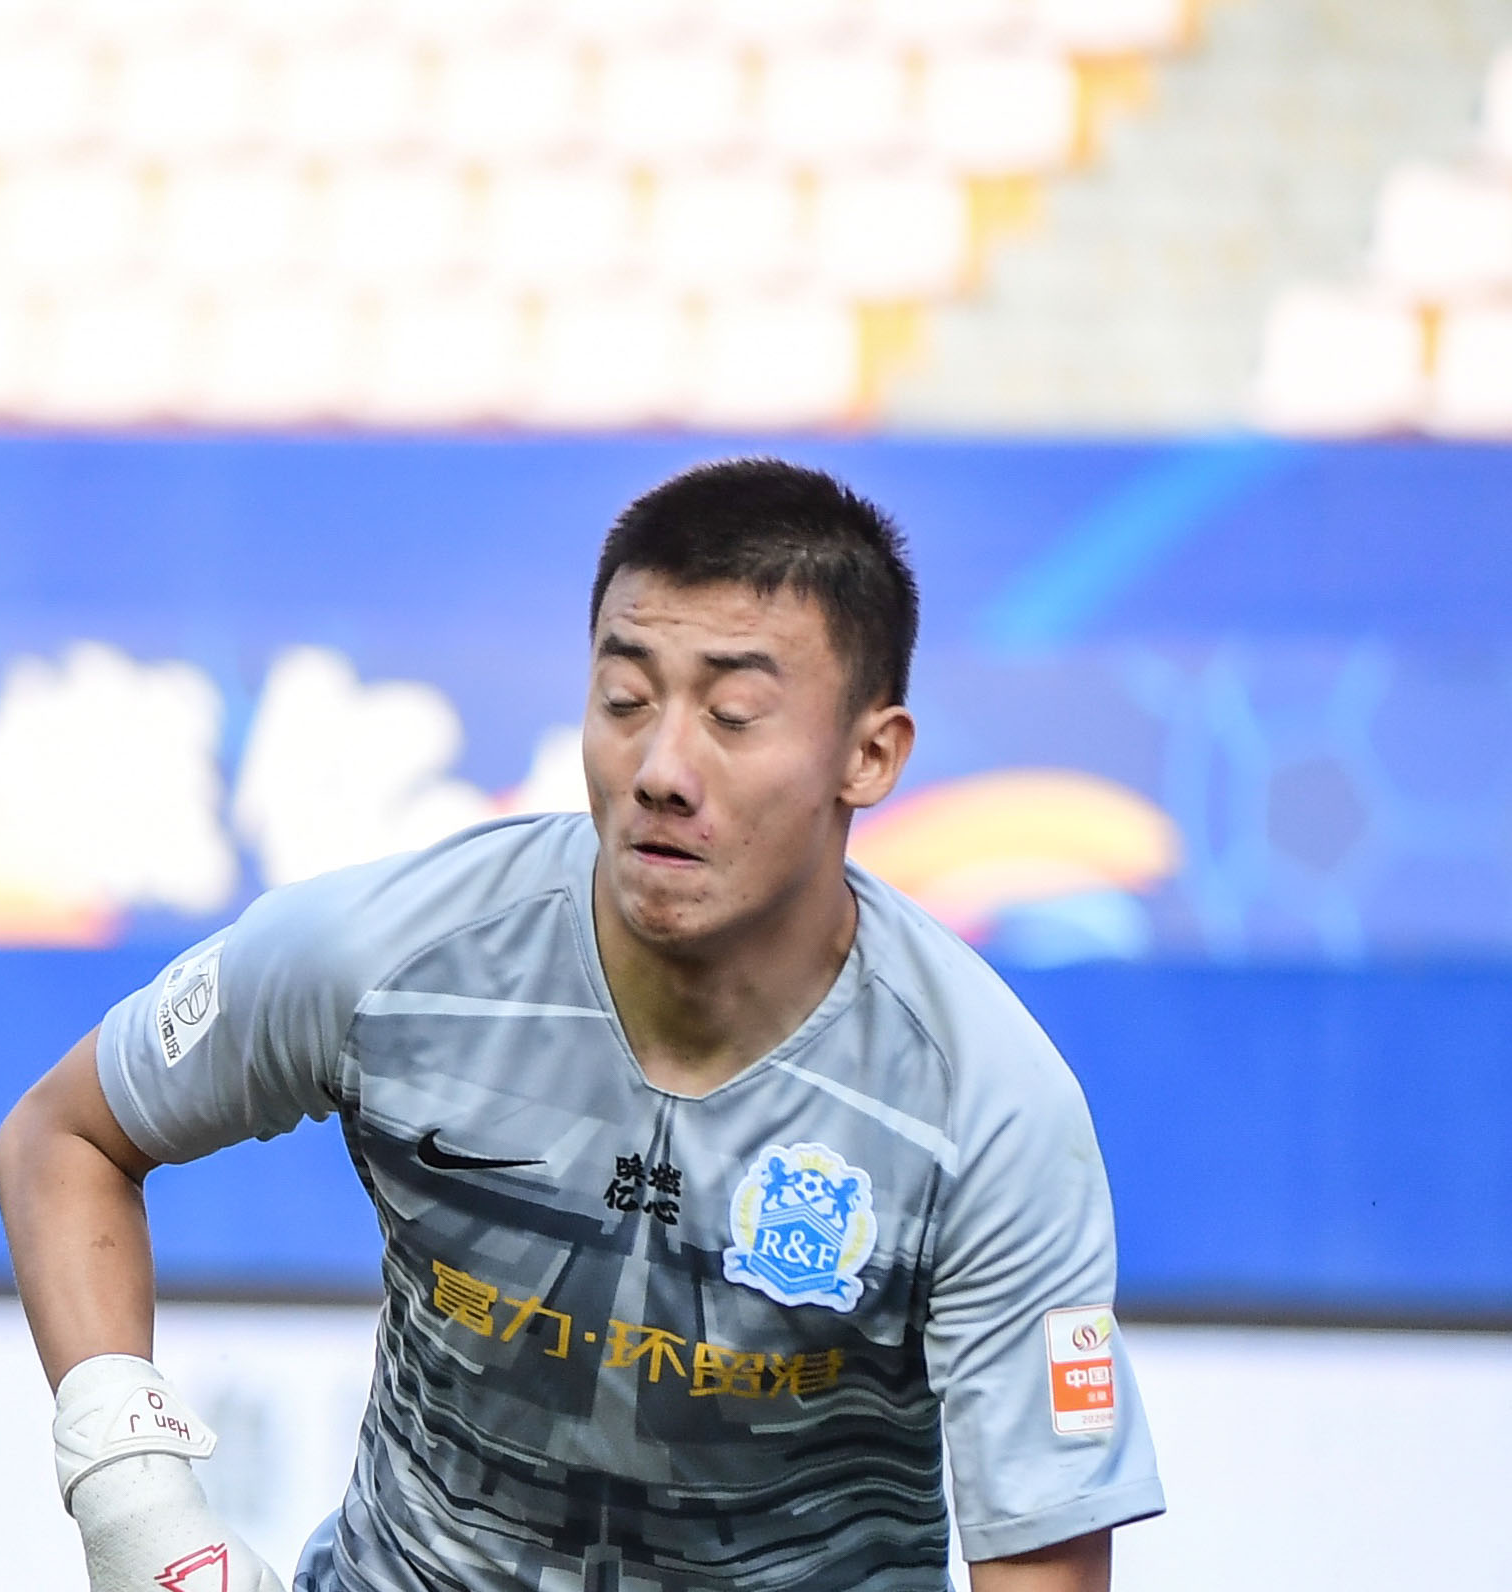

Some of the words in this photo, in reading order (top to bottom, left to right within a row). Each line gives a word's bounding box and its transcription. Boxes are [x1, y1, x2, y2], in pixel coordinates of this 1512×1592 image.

[758, 1229, 838, 1271] R&F
[1065, 1366, 1113, 1388] 中国
[129, 1413, 141, 1433] J
[154, 1413, 191, 1441] Han
